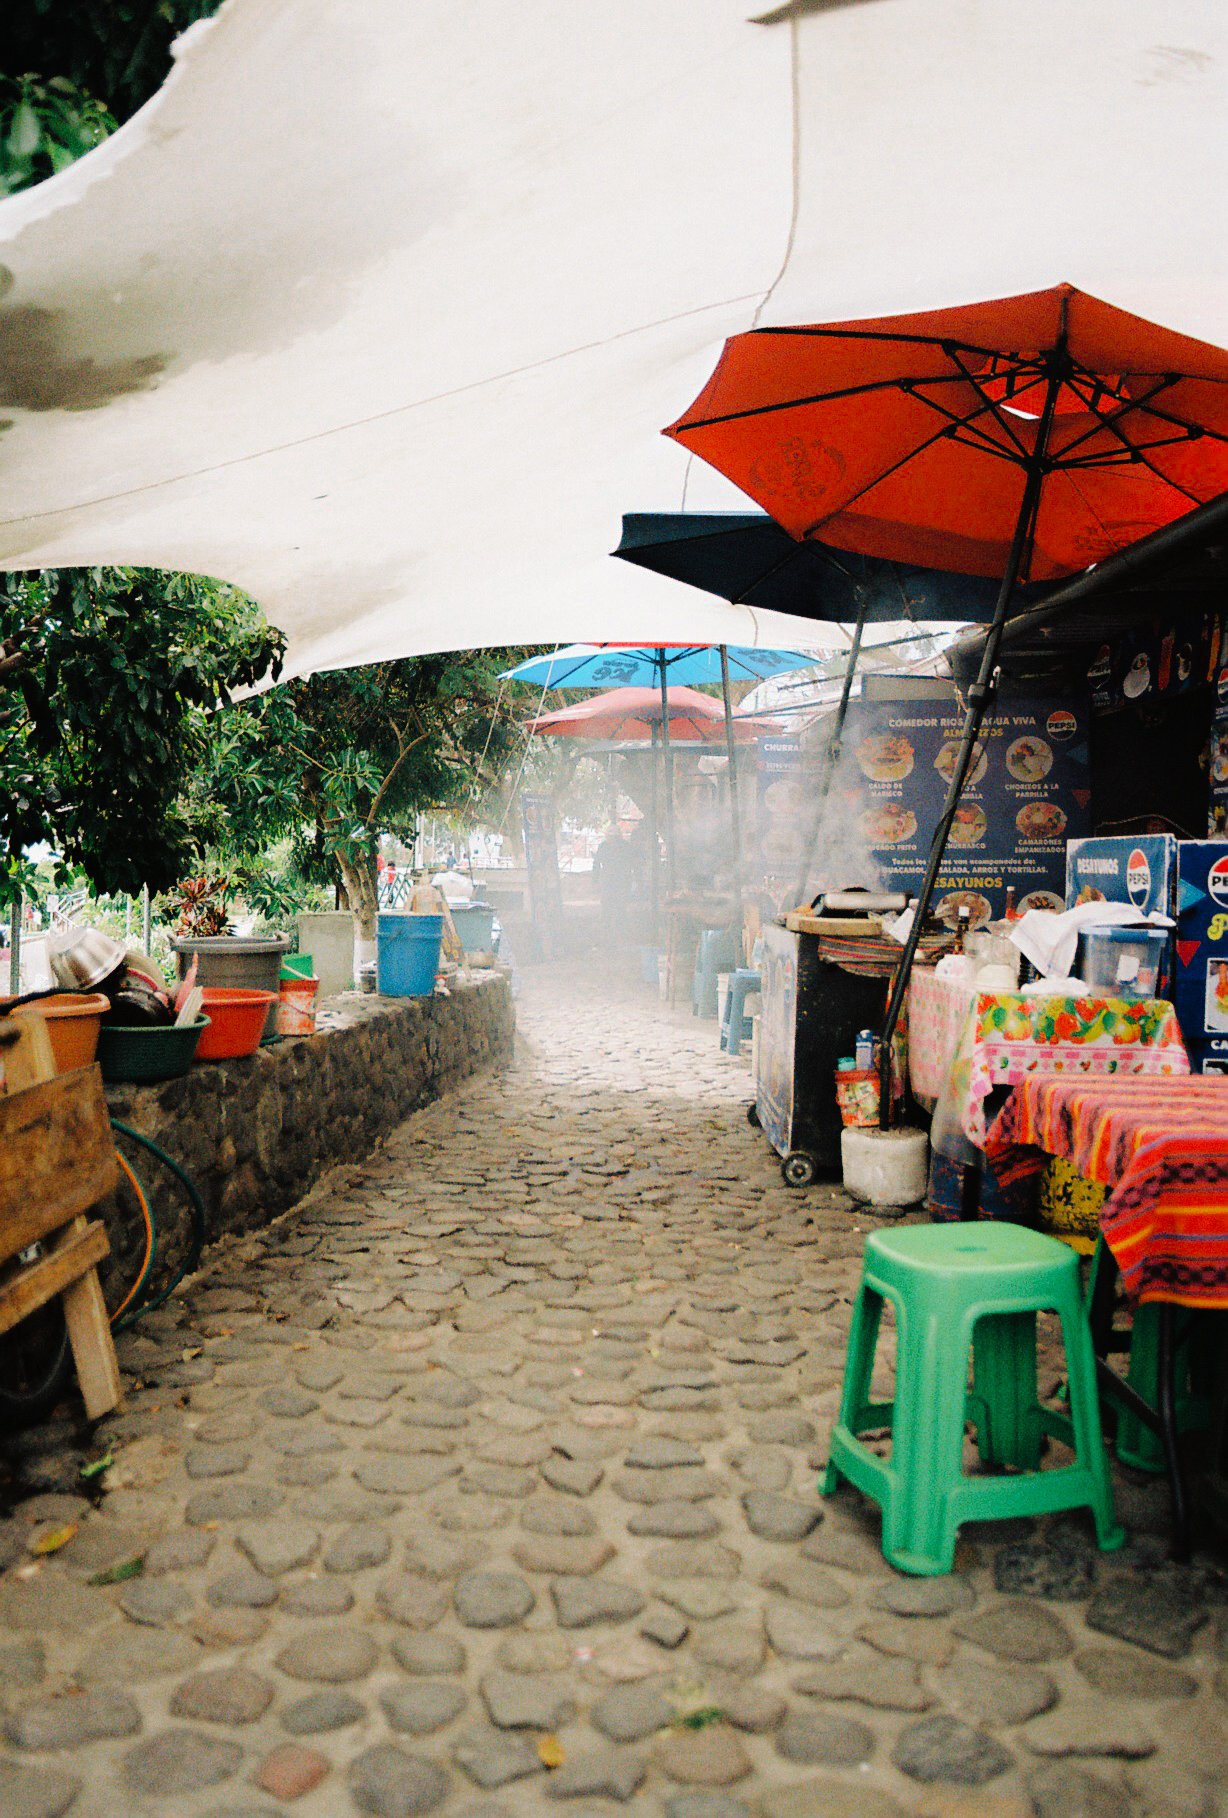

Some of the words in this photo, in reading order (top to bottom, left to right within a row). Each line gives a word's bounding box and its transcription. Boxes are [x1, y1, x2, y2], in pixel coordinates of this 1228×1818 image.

[888, 718, 937, 727] COMEDOR
[941, 717, 964, 727] RIOS
[1012, 716, 1036, 726] VIVA
[764, 743, 799, 752] CHURRA
[924, 877, 1003, 888] ESAYUNOS
